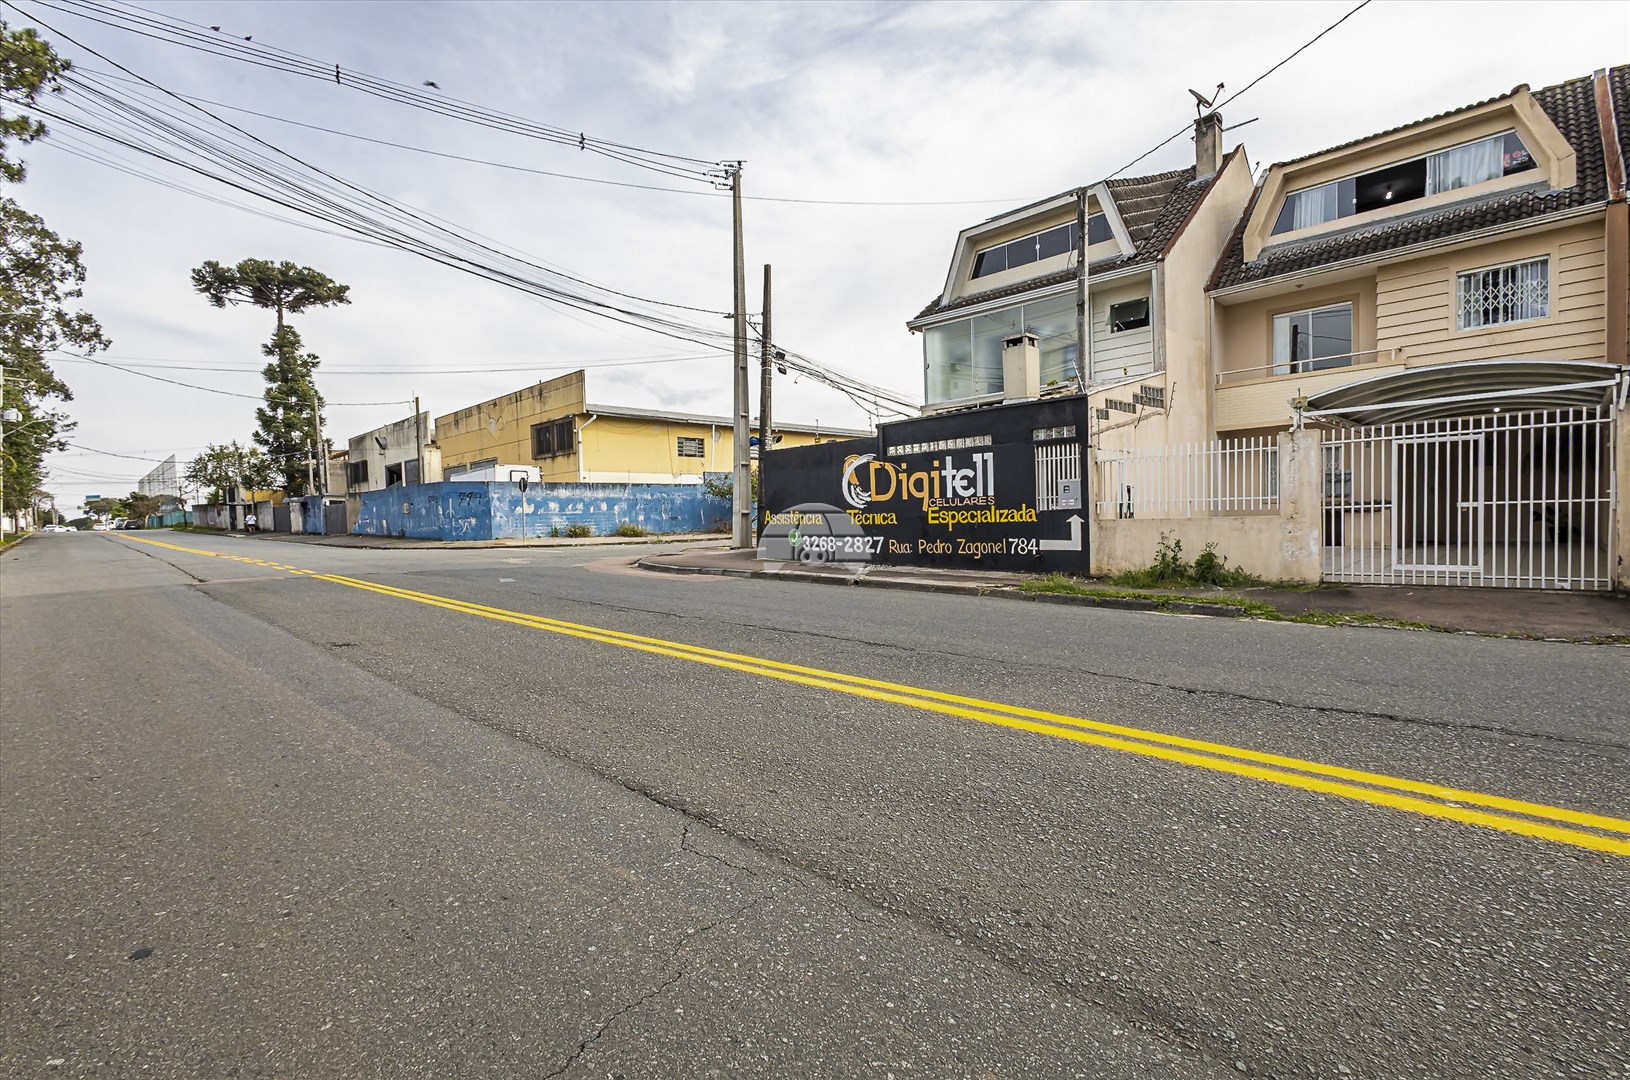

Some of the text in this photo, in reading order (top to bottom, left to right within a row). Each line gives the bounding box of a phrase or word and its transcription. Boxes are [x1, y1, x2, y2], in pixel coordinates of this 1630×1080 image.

[928, 496, 995, 507] CELULARES
[764, 503, 1038, 532] Assistência Técnica Especializada
[802, 535, 885, 554] 3268-2827
[889, 537, 1039, 559] Rua: Pedro Zagonel 784
